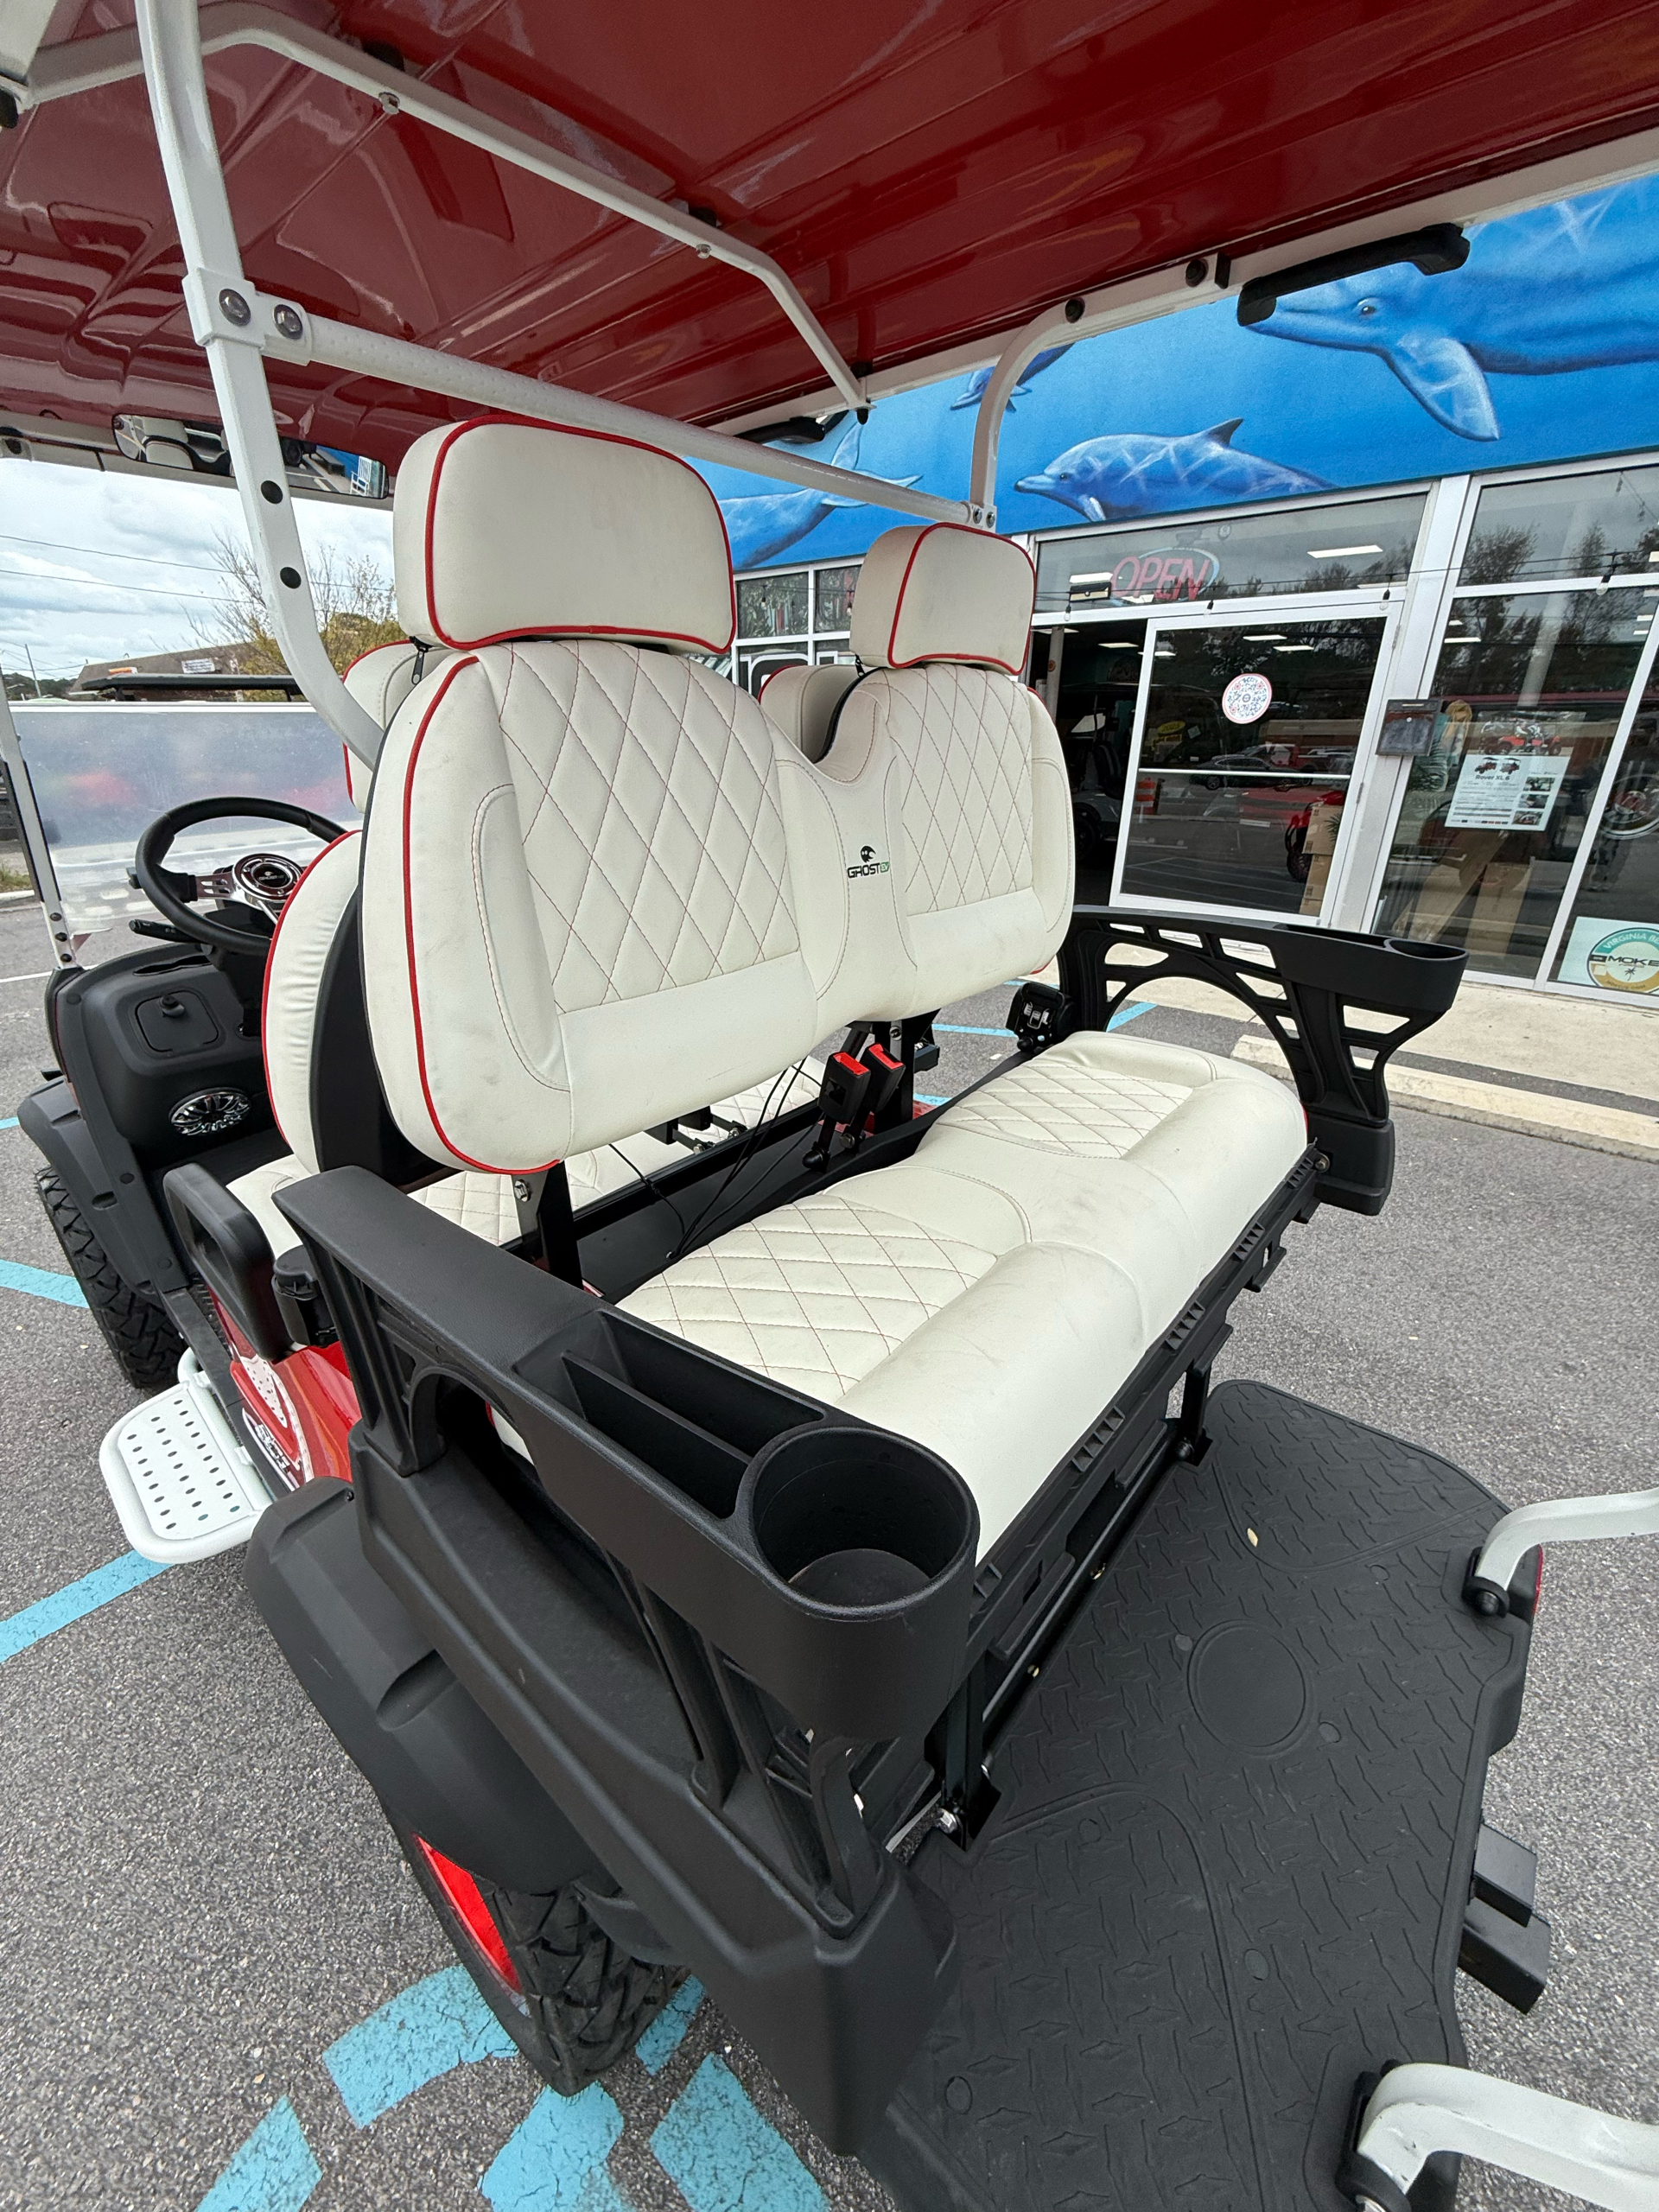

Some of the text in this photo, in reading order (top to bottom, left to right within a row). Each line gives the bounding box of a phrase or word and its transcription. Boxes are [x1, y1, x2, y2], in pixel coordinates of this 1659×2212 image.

[1111, 556, 1210, 601] OPEN
[1603, 932, 1646, 949] VIRGINIA
[1608, 955, 1659, 967] MOKE
